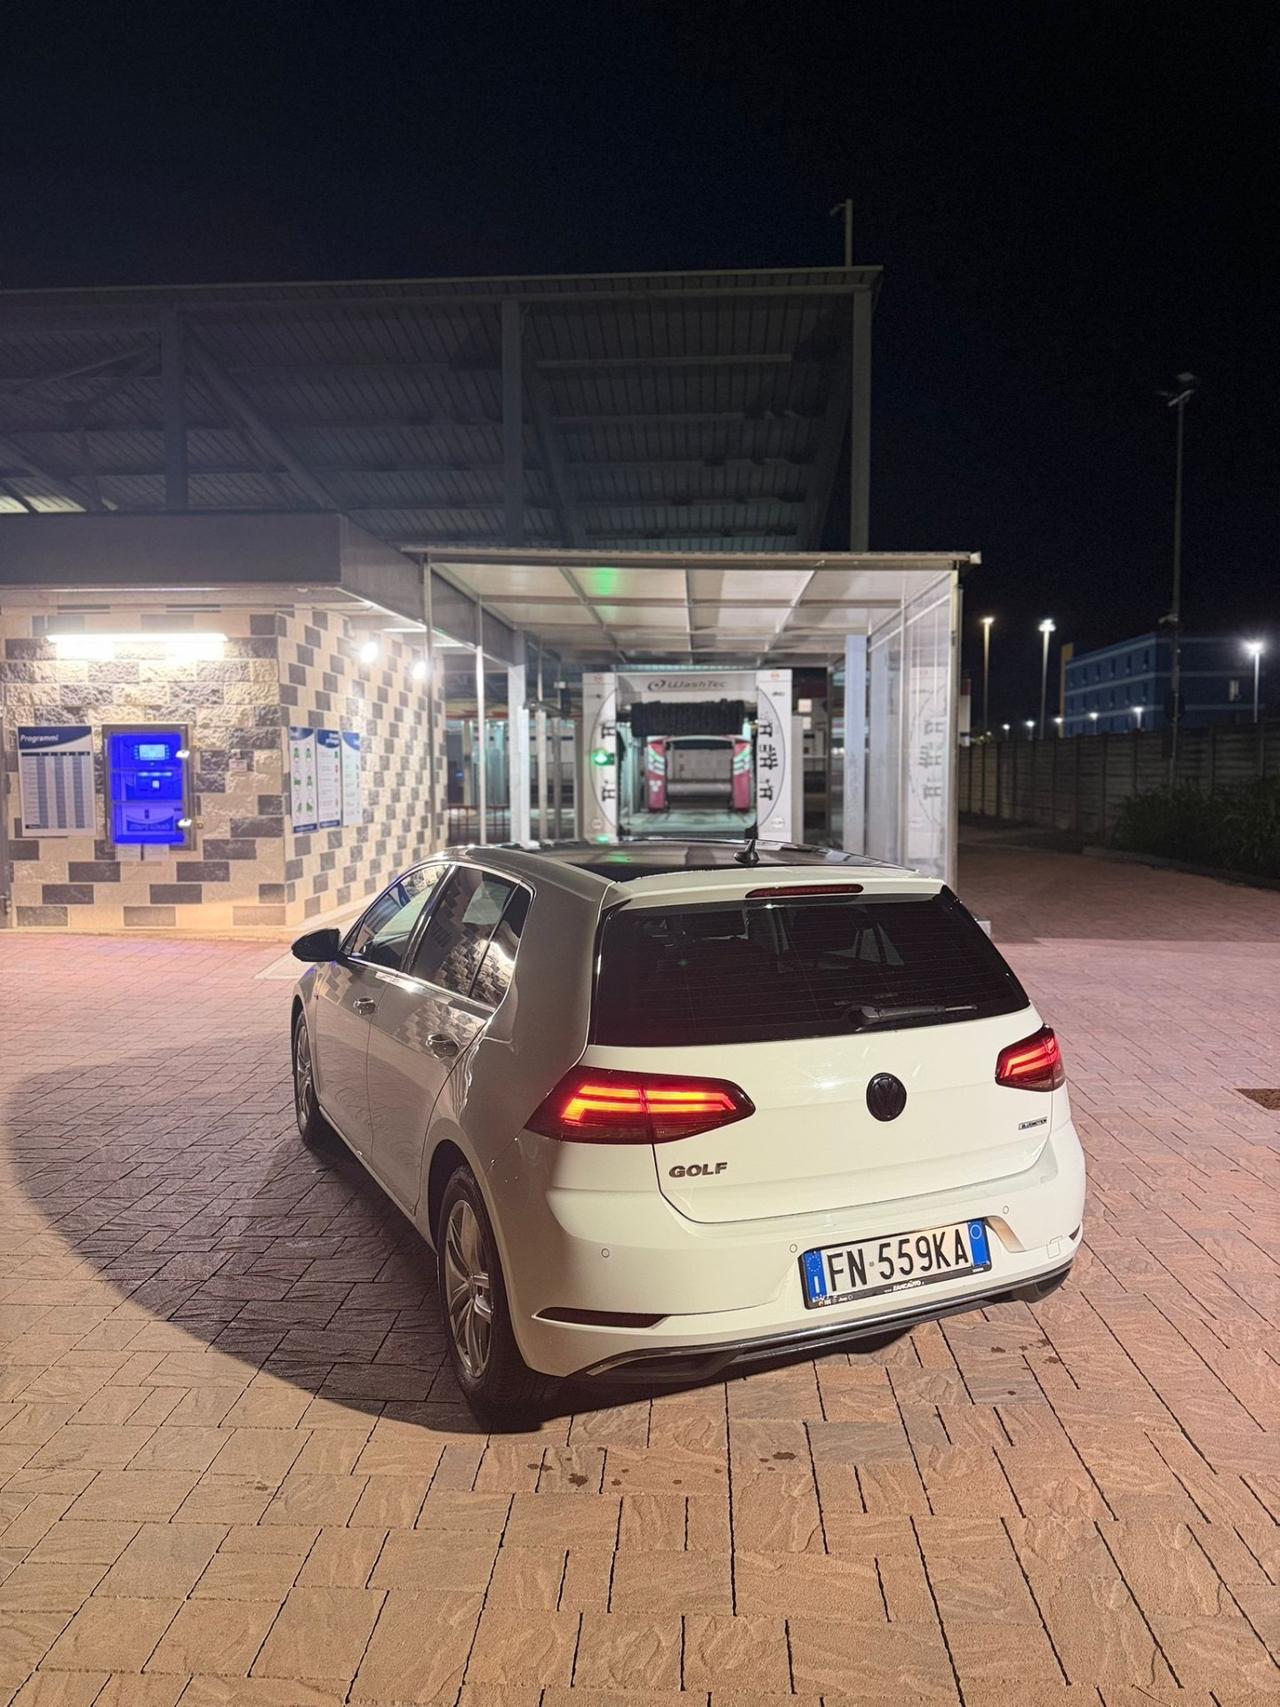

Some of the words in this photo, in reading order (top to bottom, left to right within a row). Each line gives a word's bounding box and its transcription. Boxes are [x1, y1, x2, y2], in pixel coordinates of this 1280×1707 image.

[667, 680, 729, 689] WashTec
[20, 734, 59, 743] Programmi
[668, 1161, 728, 1178] GOLF
[827, 1248, 867, 1291] FN
[878, 1229, 969, 1280] 559KA
